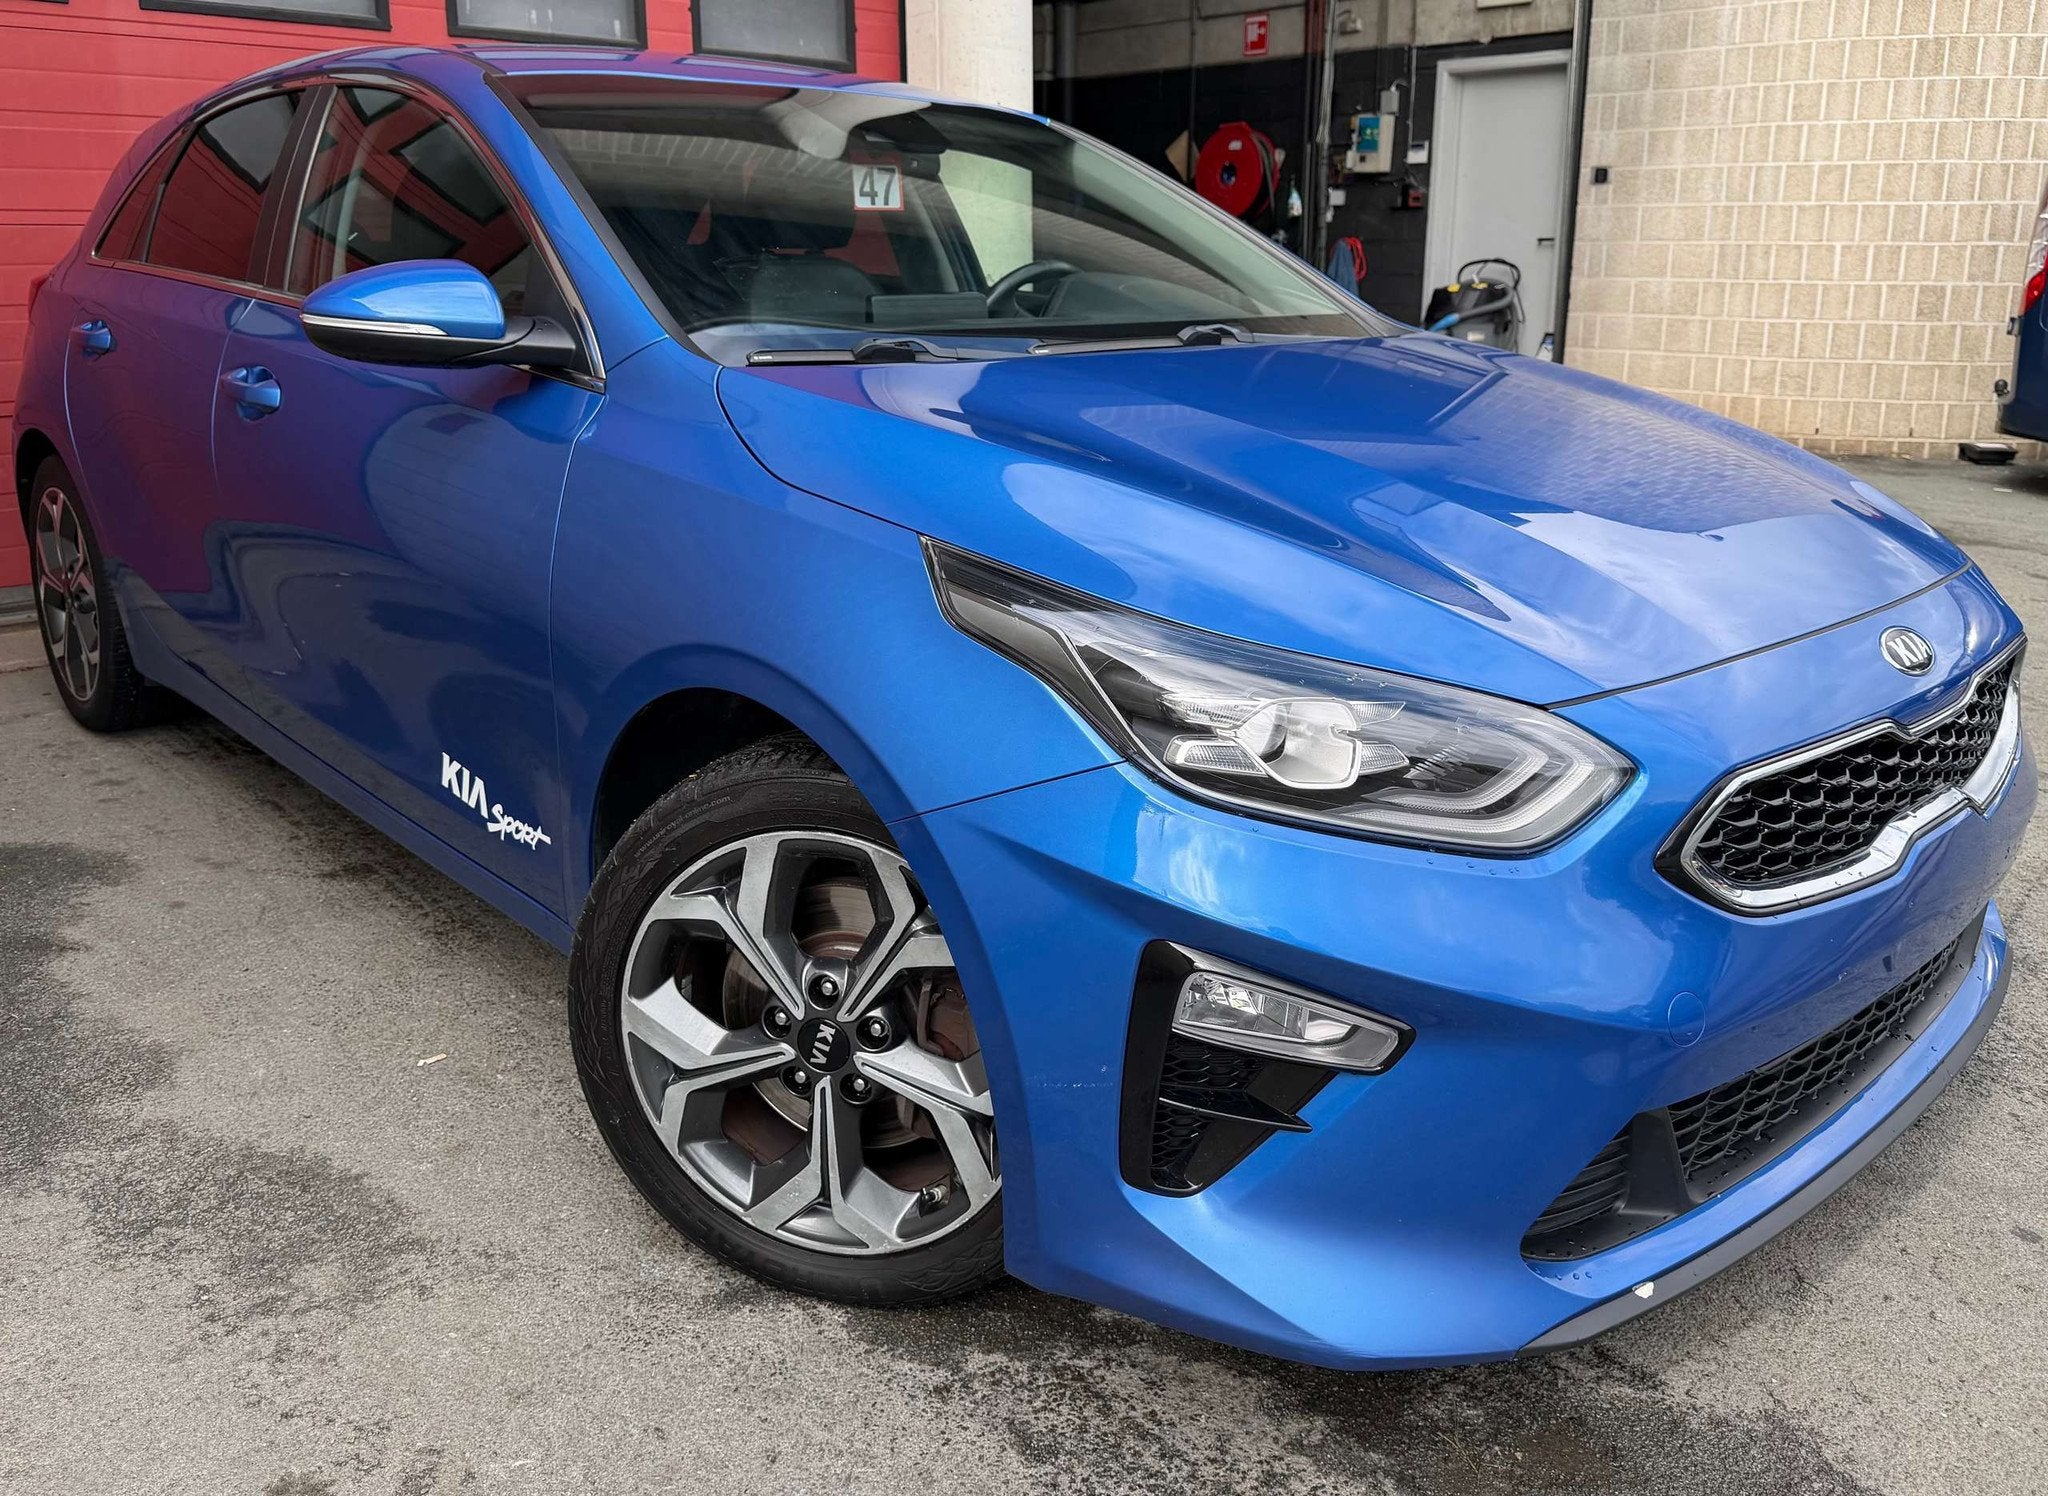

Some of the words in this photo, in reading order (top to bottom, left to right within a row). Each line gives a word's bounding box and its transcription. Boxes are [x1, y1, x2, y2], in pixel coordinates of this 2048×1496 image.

[859, 166, 896, 206] 47
[1886, 633, 1933, 667] KIA
[441, 751, 488, 819] KIA
[810, 1023, 836, 1064] KIA
